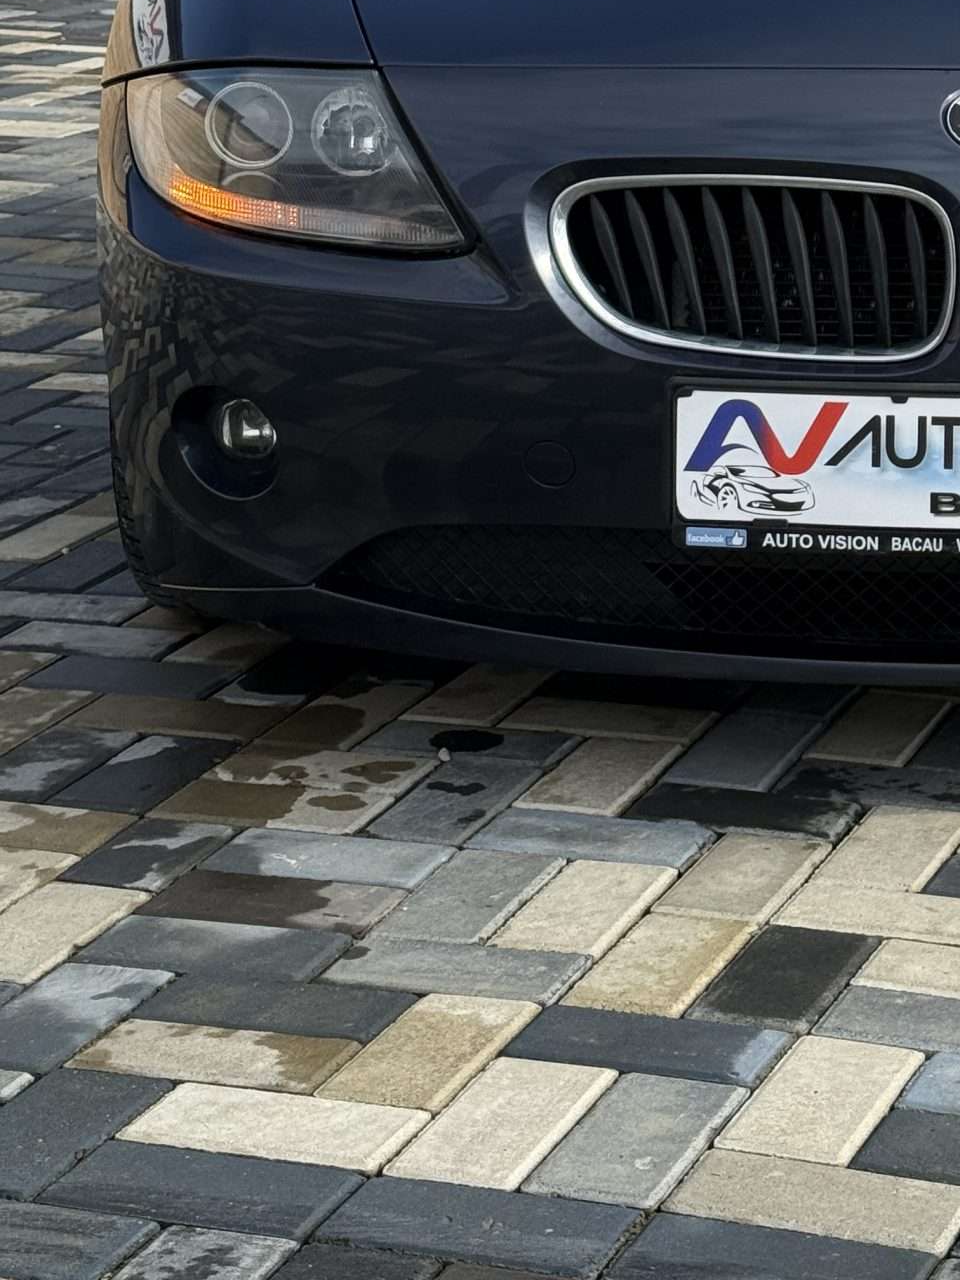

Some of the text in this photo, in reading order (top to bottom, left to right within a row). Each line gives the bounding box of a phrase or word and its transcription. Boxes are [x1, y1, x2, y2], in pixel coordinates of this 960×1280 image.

[686, 532, 726, 545] facebook
[762, 532, 814, 549] AUTO
[817, 534, 879, 551] VISION
[891, 536, 943, 552] BACAU
